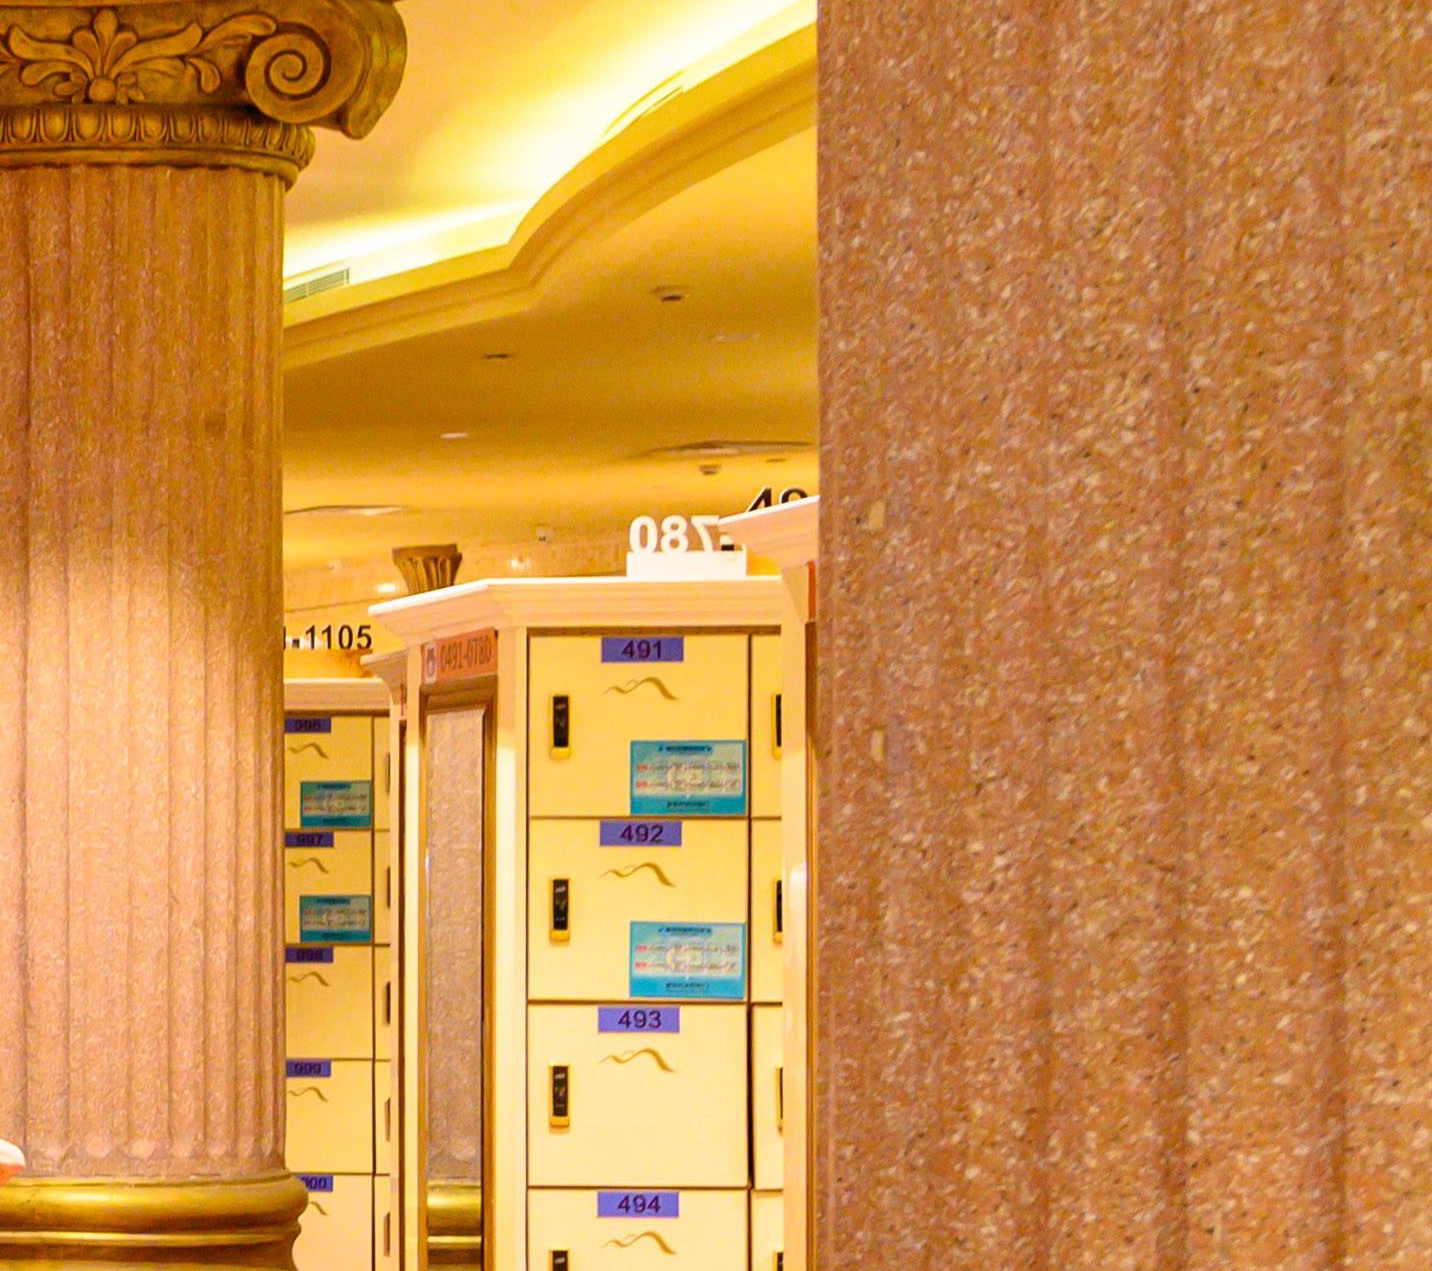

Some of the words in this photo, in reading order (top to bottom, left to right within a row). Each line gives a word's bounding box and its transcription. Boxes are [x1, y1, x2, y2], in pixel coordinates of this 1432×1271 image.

[621, 640, 663, 660] 491
[620, 824, 663, 844] 492
[618, 1010, 662, 1030] 493
[617, 1194, 661, 1215] 494
